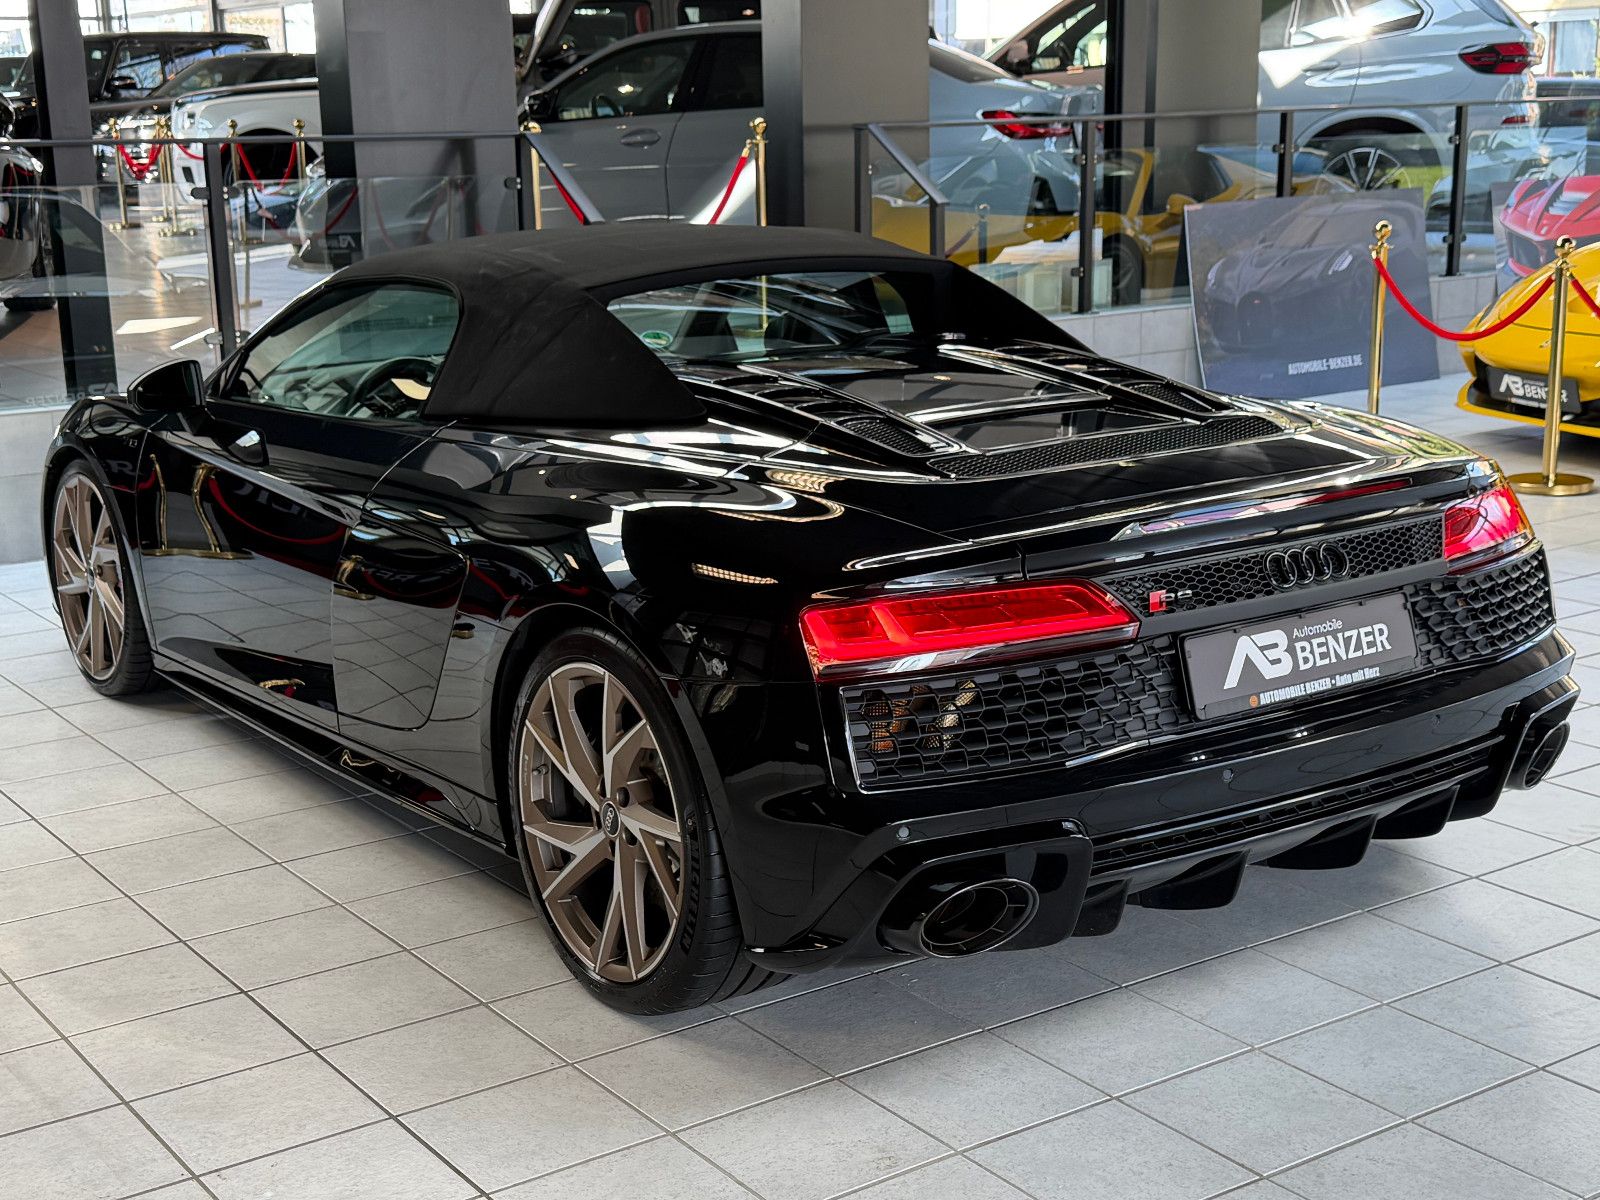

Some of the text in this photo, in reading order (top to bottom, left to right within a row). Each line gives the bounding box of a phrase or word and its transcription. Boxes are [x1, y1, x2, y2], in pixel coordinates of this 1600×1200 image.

[1524, 384, 1568, 403] BENR
[1292, 619, 1343, 639] Automobile
[1294, 623, 1393, 671] BENZER
[1223, 629, 1294, 690] AB
[1260, 667, 1380, 705] AUTOMOBILE BENZER Auto mit Herz
